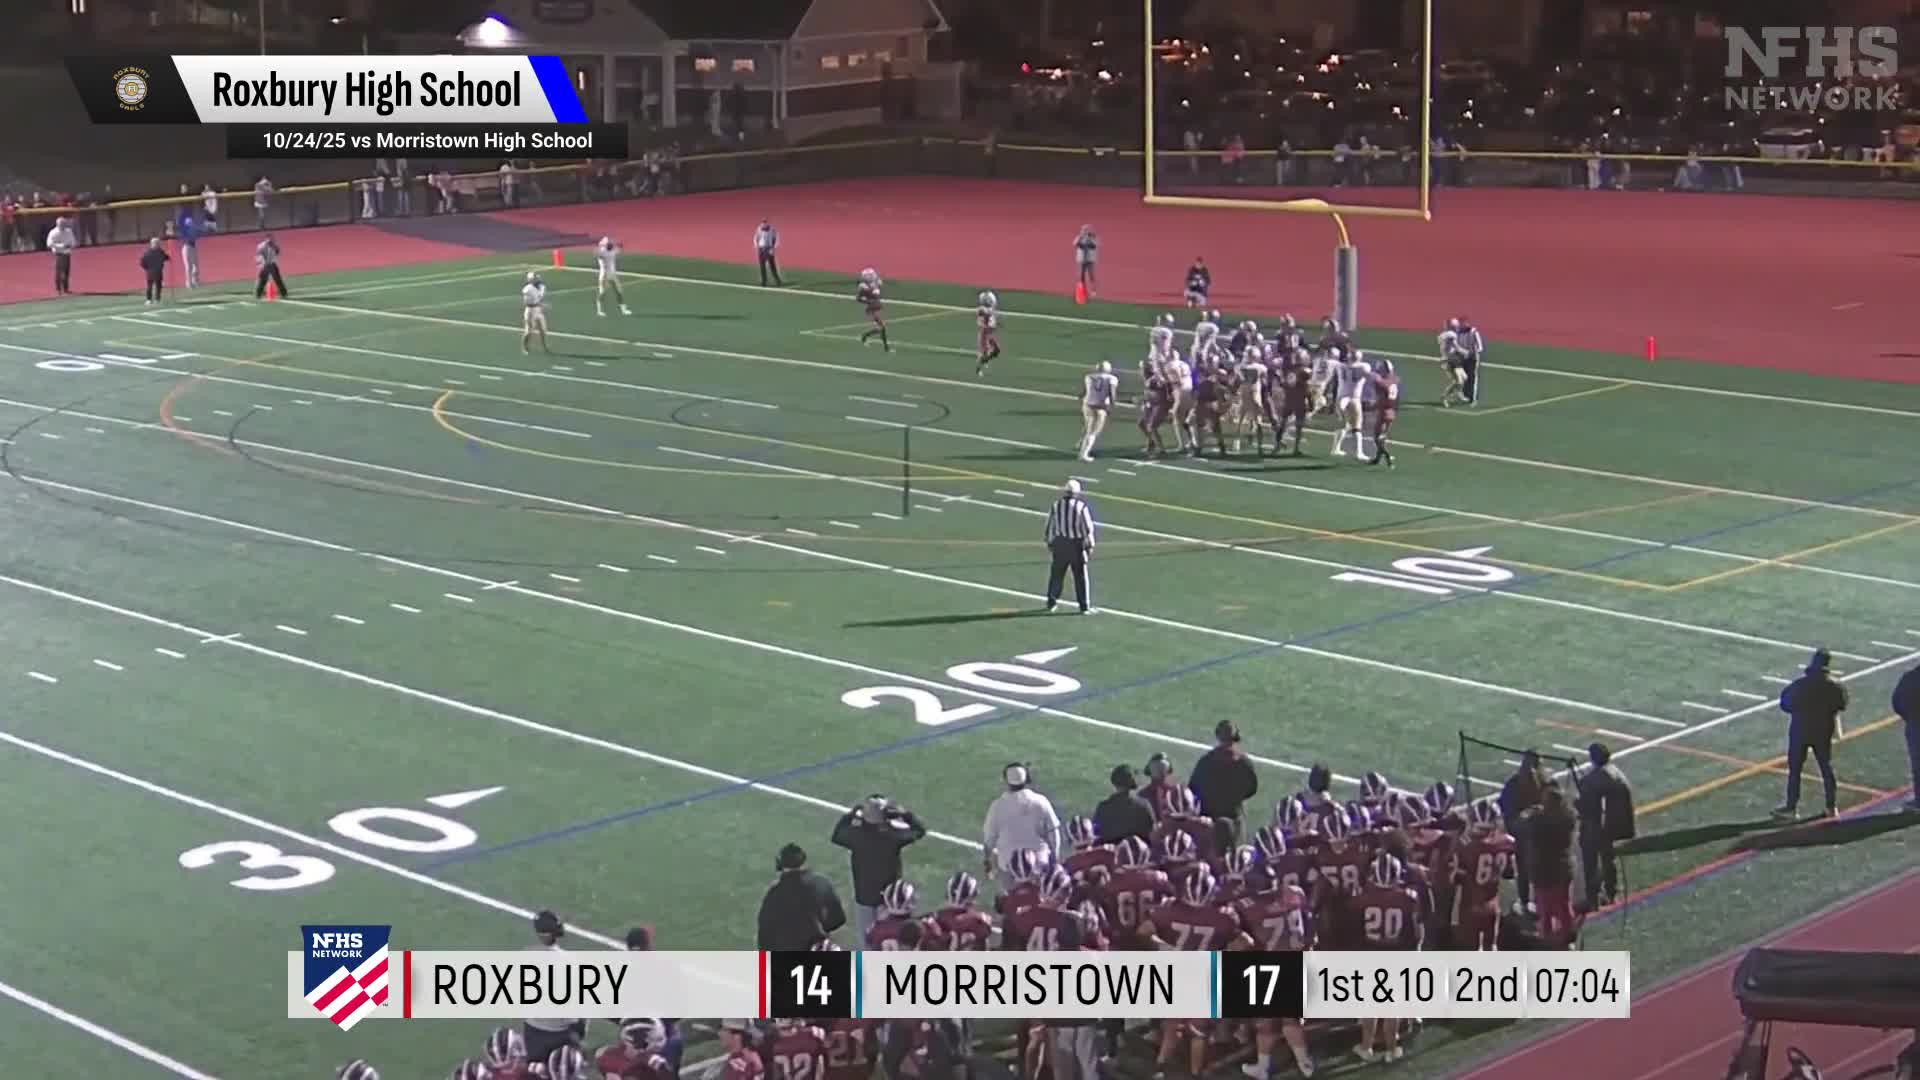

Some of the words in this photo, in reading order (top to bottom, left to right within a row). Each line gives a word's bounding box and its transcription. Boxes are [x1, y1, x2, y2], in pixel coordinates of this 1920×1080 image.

[1329, 556, 1515, 595] 10
[841, 662, 1081, 726] 20
[179, 807, 478, 890] 30
[1171, 922, 1216, 951] 77
[1364, 905, 1404, 942] 20
